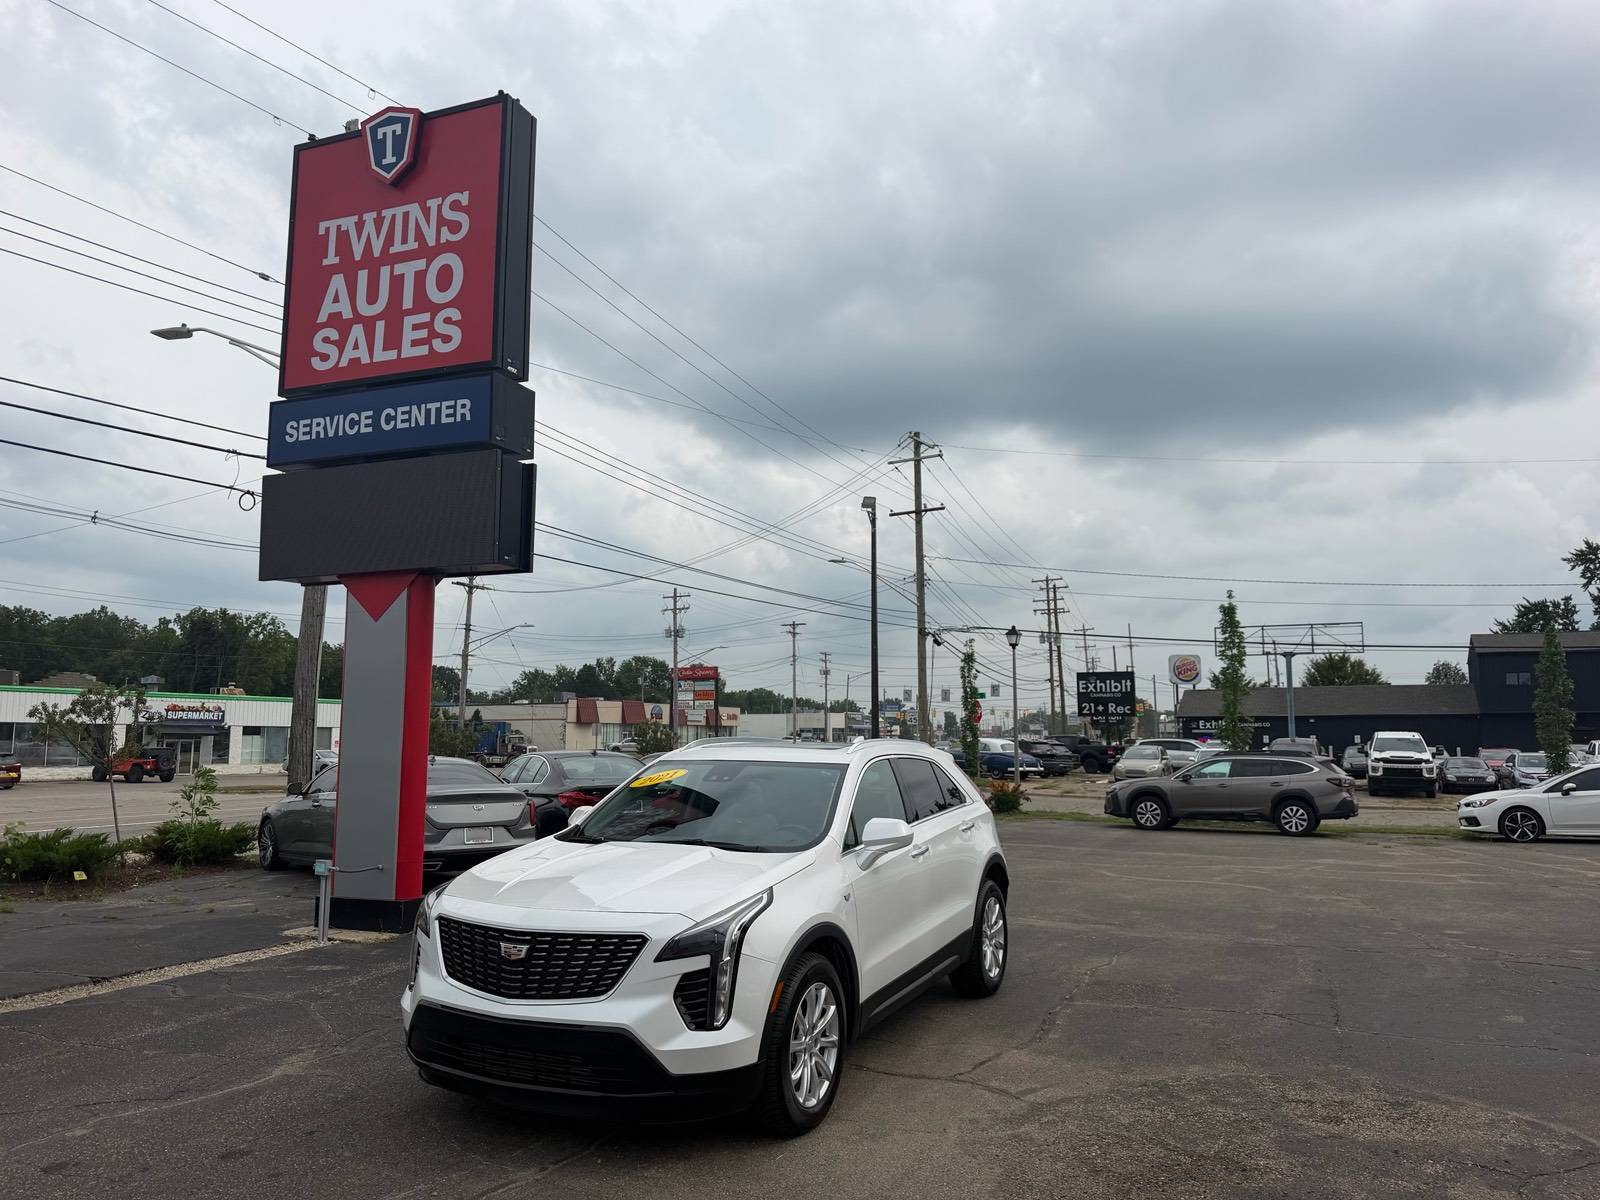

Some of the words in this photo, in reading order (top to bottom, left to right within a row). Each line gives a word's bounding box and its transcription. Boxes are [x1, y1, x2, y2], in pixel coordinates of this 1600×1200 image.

[377, 123, 402, 165] T
[318, 191, 470, 266] TWINS
[316, 252, 464, 323] AUTO
[310, 307, 462, 371] SALES
[285, 410, 374, 443] SERVICE
[380, 398, 472, 431] CENTER
[1177, 664, 1198, 676] KING
[167, 710, 223, 720] SUPERMARKET
[1082, 703, 1105, 714] 21+
[1108, 703, 1131, 714] Rec
